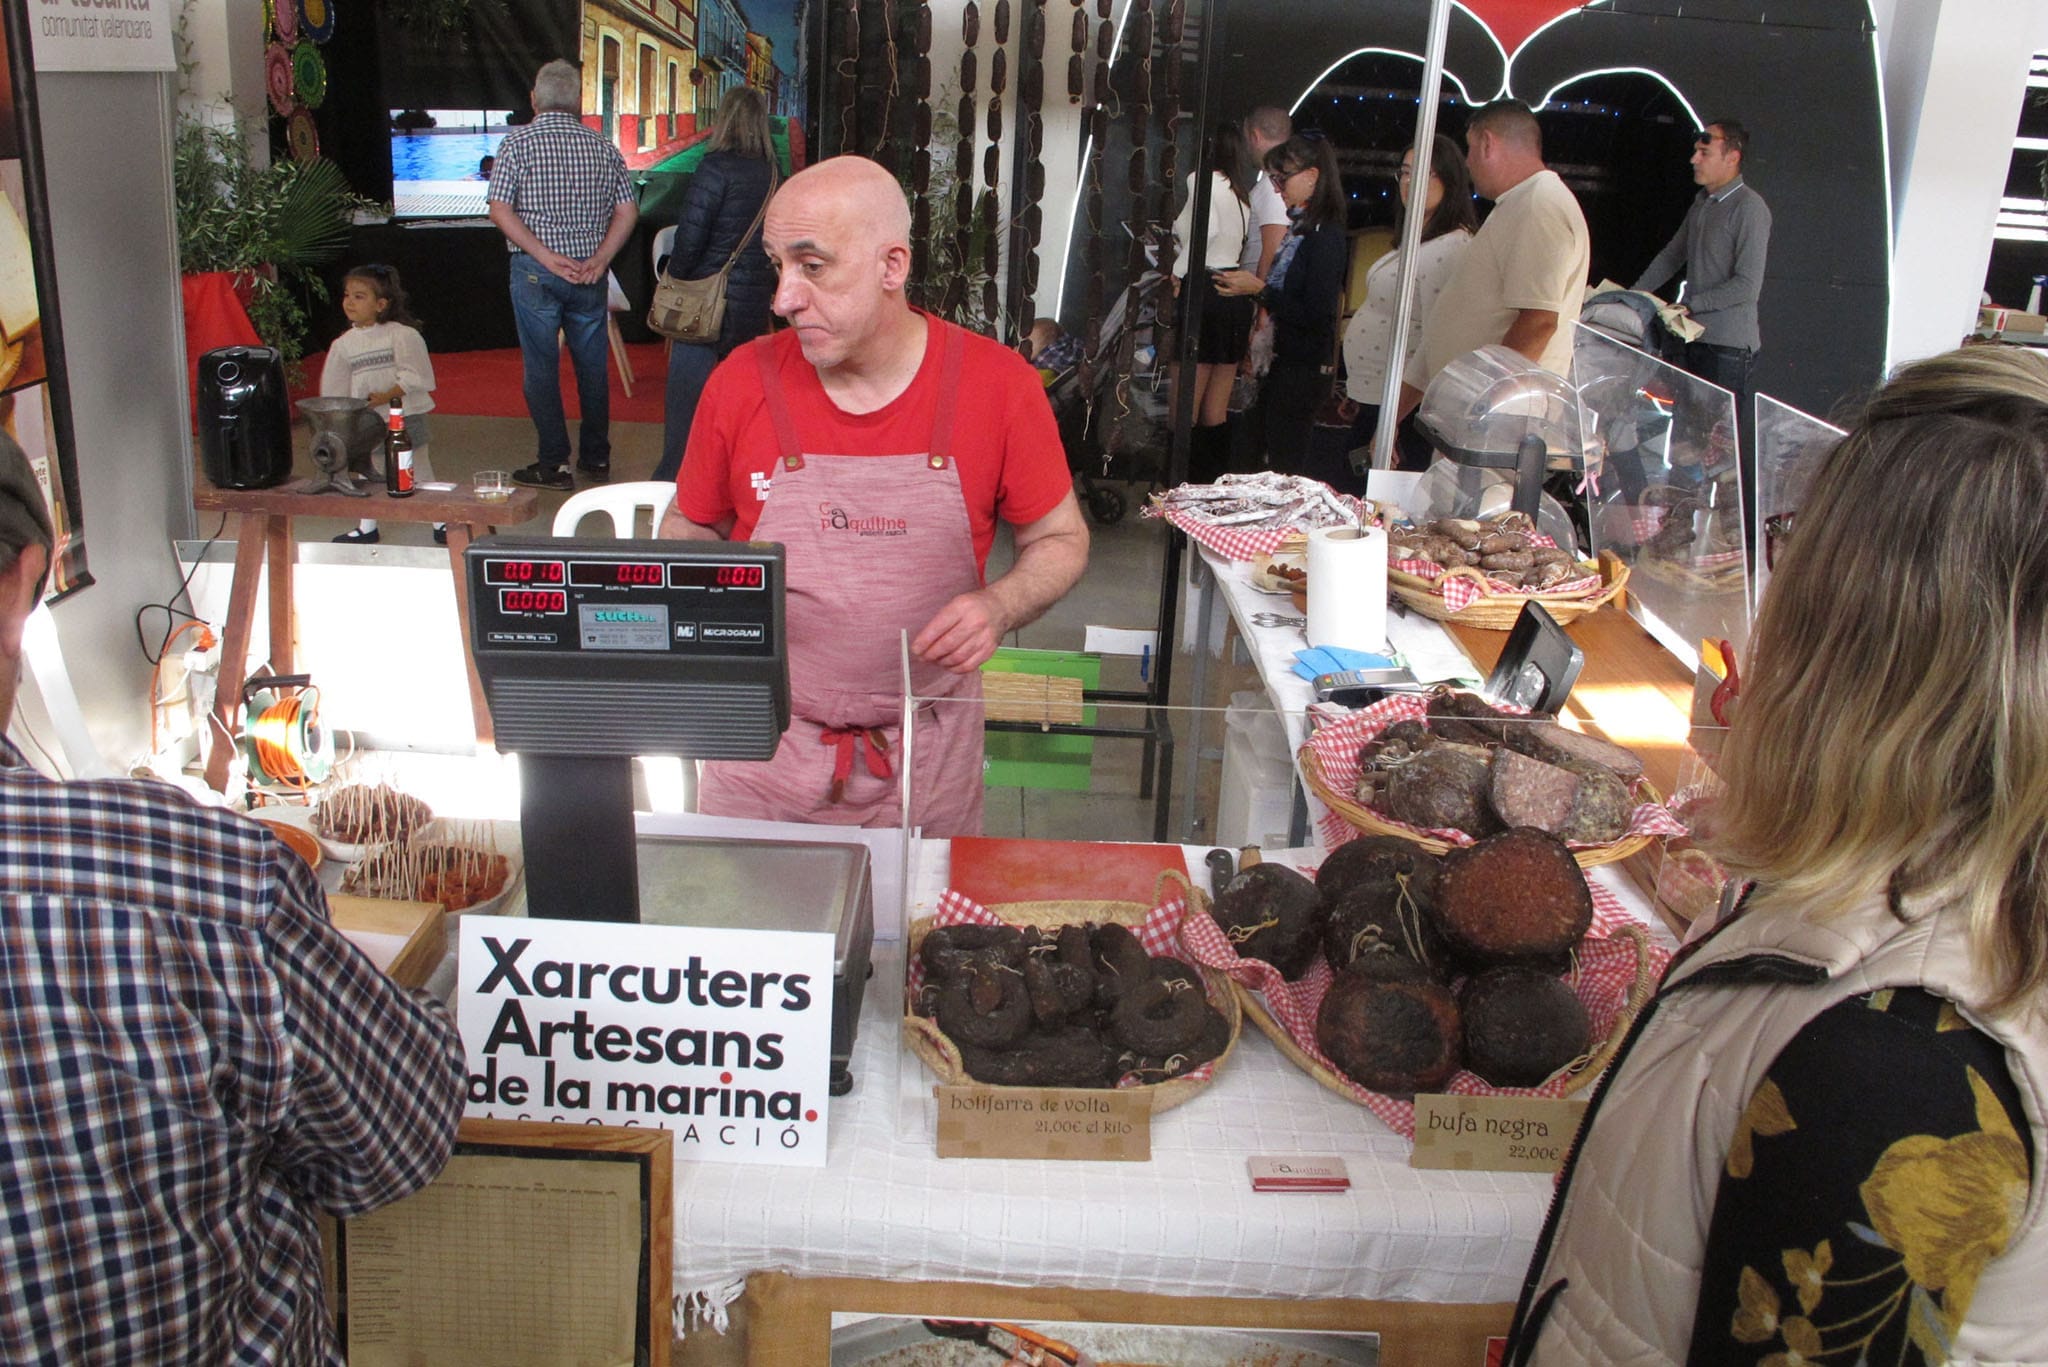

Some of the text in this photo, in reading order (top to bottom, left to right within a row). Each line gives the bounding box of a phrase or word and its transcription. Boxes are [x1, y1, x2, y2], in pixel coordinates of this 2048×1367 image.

[41, 15, 152, 39] comunitat valenciana
[476, 936, 812, 1012] Xarcuters
[482, 998, 785, 1071] Artesans
[467, 1056, 818, 1122] de la marina.
[1040, 1097, 1060, 1112] de
[1086, 1120, 1099, 1134] el
[1104, 1120, 1133, 1134] kilo
[1428, 1110, 1550, 1141] bufa negra
